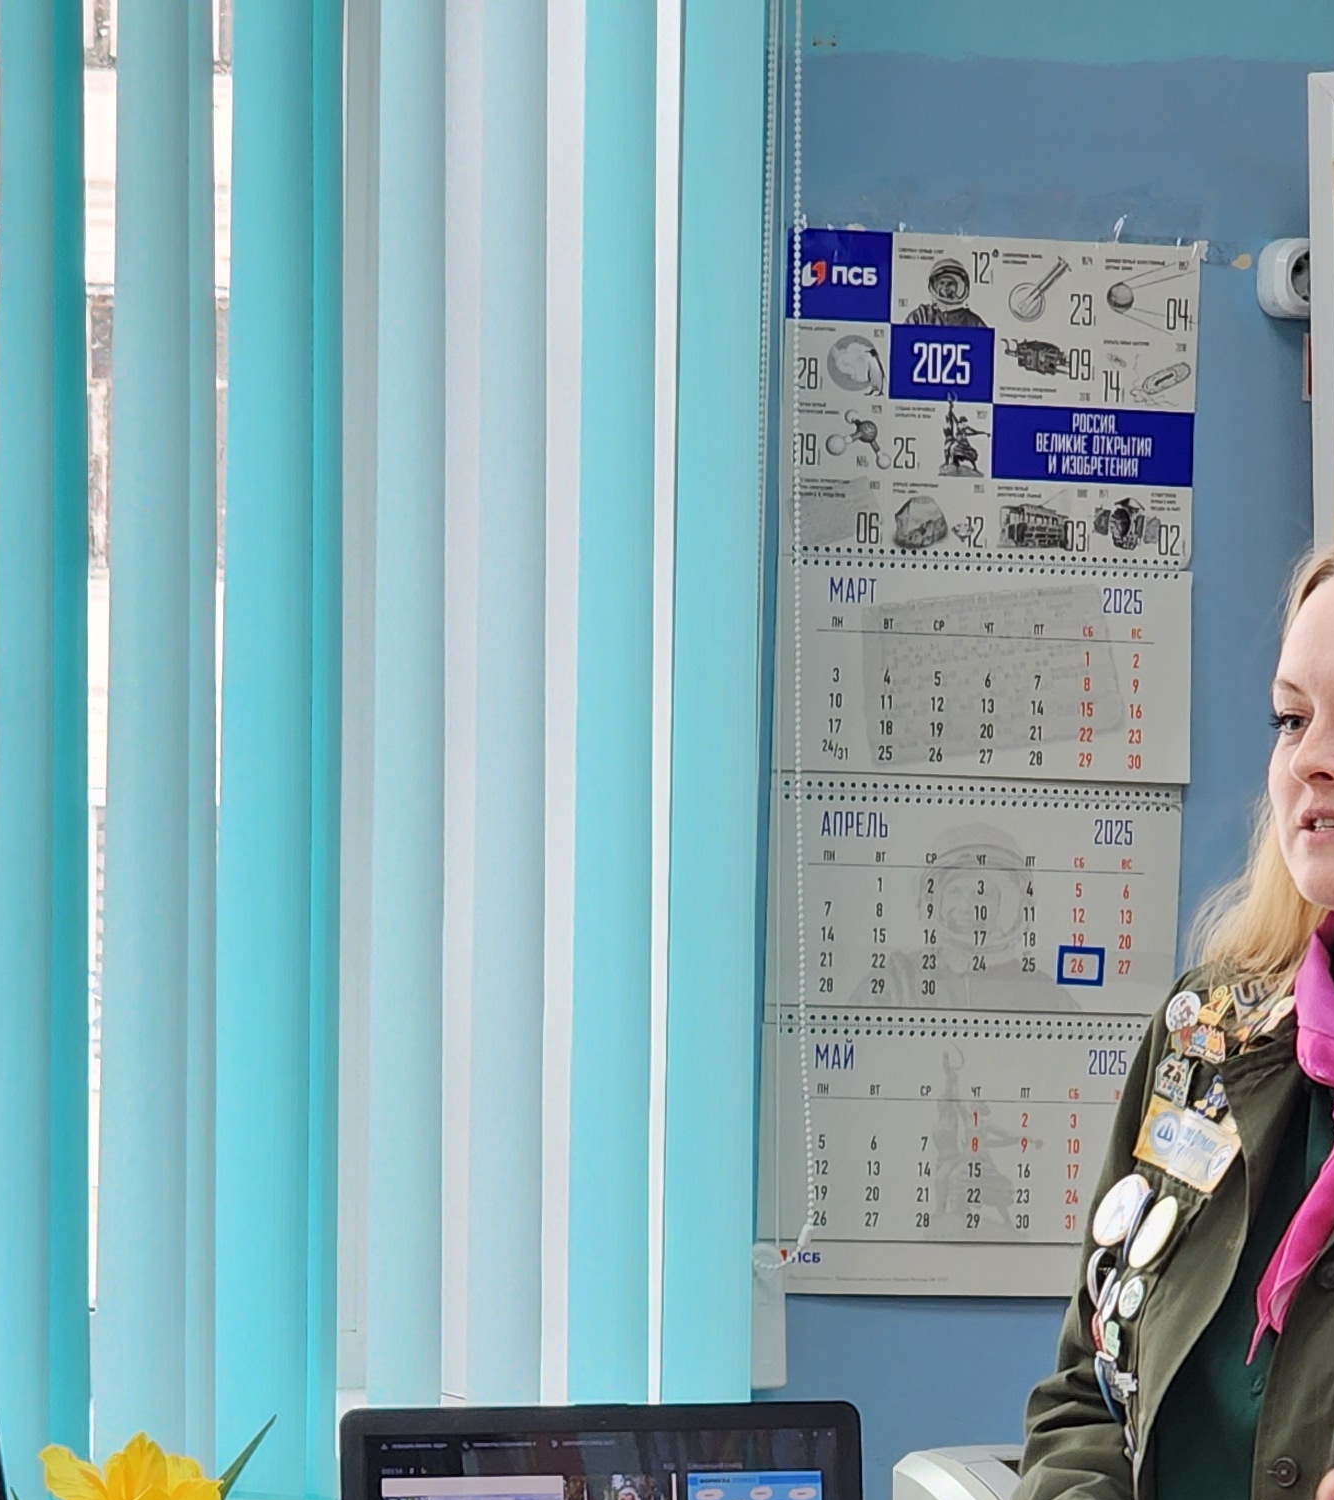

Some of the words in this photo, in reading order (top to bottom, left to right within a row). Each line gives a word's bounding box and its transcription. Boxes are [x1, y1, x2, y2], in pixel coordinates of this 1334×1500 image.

[831, 265, 878, 286] ПСБ
[971, 251, 990, 285] 12
[1069, 293, 1093, 327] 23
[1166, 297, 1189, 332] 04
[796, 356, 819, 390] 28
[912, 341, 971, 385] 2025
[1068, 348, 1091, 381] 09
[1102, 370, 1121, 403] 14
[892, 436, 917, 470] 25
[1035, 432, 1089, 455] ВЕЛИКИЕ
[1092, 434, 1153, 457] ОТКРЫТИЯ
[1047, 453, 1057, 475] И
[1061, 454, 1139, 478] ИЗОБРЕТЕНИЯ
[855, 511, 880, 545] 06
[965, 515, 985, 549] 12
[1063, 519, 1087, 552] 03
[1157, 524, 1181, 557] 02
[828, 576, 877, 605] МАРТ
[1102, 587, 1143, 615] 2025
[831, 615, 844, 628] ПН
[883, 617, 894, 630] ВТ
[933, 619, 945, 632] СР
[984, 622, 995, 634] ЧТ
[1033, 624, 1045, 636] ПТ
[1082, 625, 1094, 638] СБ
[1131, 627, 1142, 640] ВС
[1085, 650, 1090, 667] 1
[1132, 653, 1140, 669] 2
[832, 667, 840, 683] 3
[883, 668, 891, 685] 4
[934, 670, 942, 687] 5
[984, 672, 992, 689] 6
[1034, 674, 1042, 691] 7
[1083, 676, 1091, 692] 8
[1132, 678, 1140, 694] 9
[829, 692, 843, 709] 10
[880, 694, 893, 710] 11
[930, 696, 944, 713] 12
[981, 698, 995, 714] 13
[1030, 700, 1044, 716] 14
[1080, 701, 1094, 718] 15
[1129, 703, 1143, 719] 16
[828, 717, 842, 734] 17
[879, 719, 893, 736] 18
[930, 721, 944, 738] 19
[980, 723, 994, 740] 20
[1029, 725, 1042, 741] 21
[1079, 726, 1094, 743] 22
[1128, 728, 1142, 745] 23
[878, 745, 893, 761] 25
[928, 746, 943, 763] 26
[979, 748, 994, 764] 27
[1029, 750, 1043, 766] 28
[1078, 752, 1093, 768] 29
[1128, 754, 1142, 770] 30
[820, 810, 889, 840] АПРЕЛЬ
[1094, 819, 1134, 847] 2025
[823, 849, 836, 861] ПН
[875, 851, 886, 863] ВТ
[925, 852, 938, 865] СР
[976, 854, 987, 866] ЧТ
[1025, 855, 1036, 867] ПТ
[1073, 856, 1085, 869] СБ
[1121, 858, 1133, 870] ВС
[877, 876, 883, 893] 1
[927, 877, 935, 895] 2
[976, 879, 985, 896] 3
[1026, 880, 1034, 898] 4
[1075, 882, 1083, 898] 5
[1122, 884, 1130, 900] 6
[824, 900, 832, 917] 7
[876, 902, 883, 918] 8
[926, 903, 934, 920] 9
[974, 905, 988, 921] 10
[1023, 906, 1035, 922] 11
[1072, 907, 1085, 924] 12
[1120, 909, 1133, 925] 13
[821, 926, 835, 942] 14
[872, 927, 887, 944] 15
[923, 928, 937, 945] 16
[973, 929, 987, 946] 17
[1022, 931, 1036, 947] 18
[1071, 933, 1085, 949] 19
[1118, 934, 1132, 950] 20
[820, 951, 833, 968] 21
[871, 953, 886, 969] 22
[922, 953, 937, 970] 23
[972, 955, 987, 972] 24
[1021, 956, 1036, 973] 25
[1070, 958, 1085, 974] 26
[1118, 959, 1132, 975] 27
[819, 977, 834, 993] 28
[871, 978, 885, 994] 29
[921, 979, 936, 996] 30
[814, 1038, 855, 1071] МАЙ
[1087, 1049, 1128, 1077] 2025
